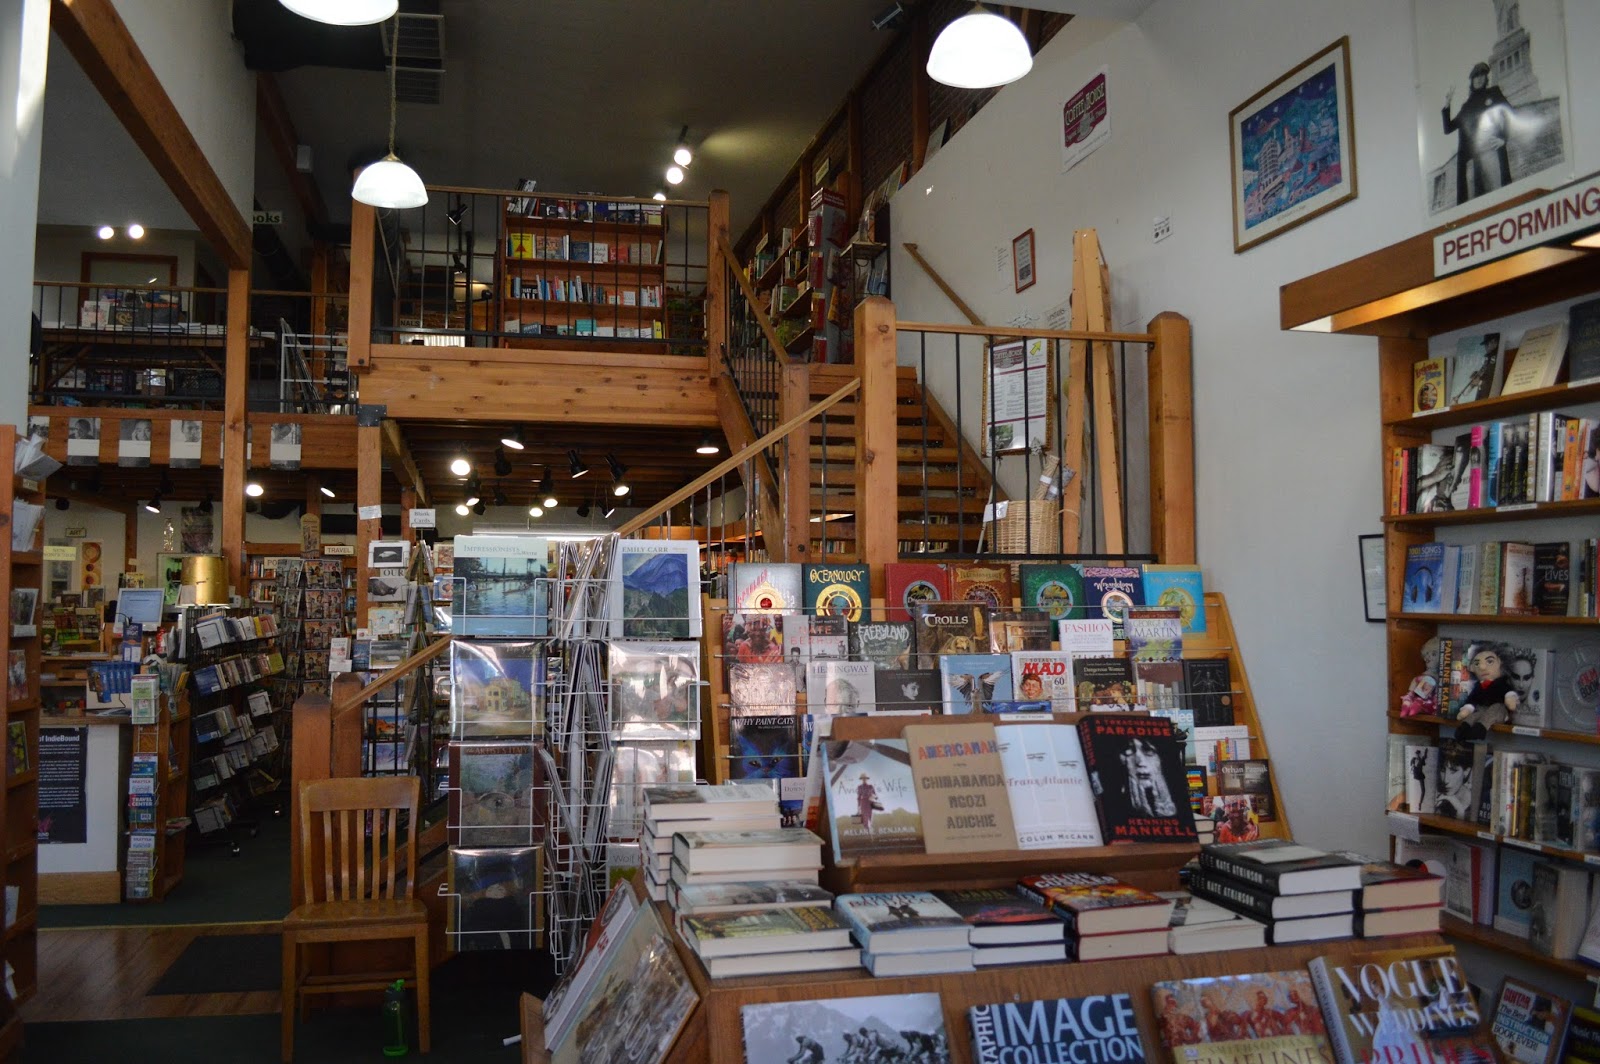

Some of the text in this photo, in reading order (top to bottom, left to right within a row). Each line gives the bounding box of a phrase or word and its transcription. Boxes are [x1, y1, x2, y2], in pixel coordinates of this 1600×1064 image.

[1443, 187, 1600, 265] PERFORMING
[383, 569, 404, 577] OUR
[810, 569, 865, 583] OCEANOLOGY
[1064, 623, 1111, 633] FASHION
[1134, 627, 1178, 638] MARTIN
[1021, 662, 1066, 676] MAD
[1054, 677, 1065, 686] 60
[1440, 640, 1453, 715] PAULINE KAEL
[734, 718, 754, 729] WHY
[755, 717, 777, 725] PAINT
[777, 717, 794, 725] CATS
[1096, 726, 1172, 737] PARADISE
[919, 740, 998, 760] AMERICANAH
[1221, 766, 1244, 774] Orhan
[922, 774, 1005, 790] CHIMAMANDA
[1007, 776, 1083, 788] TransAtlantic
[948, 794, 987, 809] NGOZI
[947, 814, 997, 829] ADICHIE
[1019, 833, 1053, 843] COLUM
[1115, 825, 1197, 837] MANKELL
[1216, 859, 1263, 884] KATE ATKINSON
[1207, 880, 1254, 907] KATE ATKINSON
[1333, 957, 1469, 1003] VOGUE
[1503, 988, 1531, 1010] GUITAR
[991, 993, 1138, 1047] IMAGE
[1349, 1002, 1481, 1038] WDDINGS
[1500, 1005, 1527, 1021] The Best
[1497, 1014, 1549, 1043] INSTRUCTION
[1493, 1024, 1538, 1051] BOOK EVER!
[999, 1035, 1145, 1064] COLLECTION
